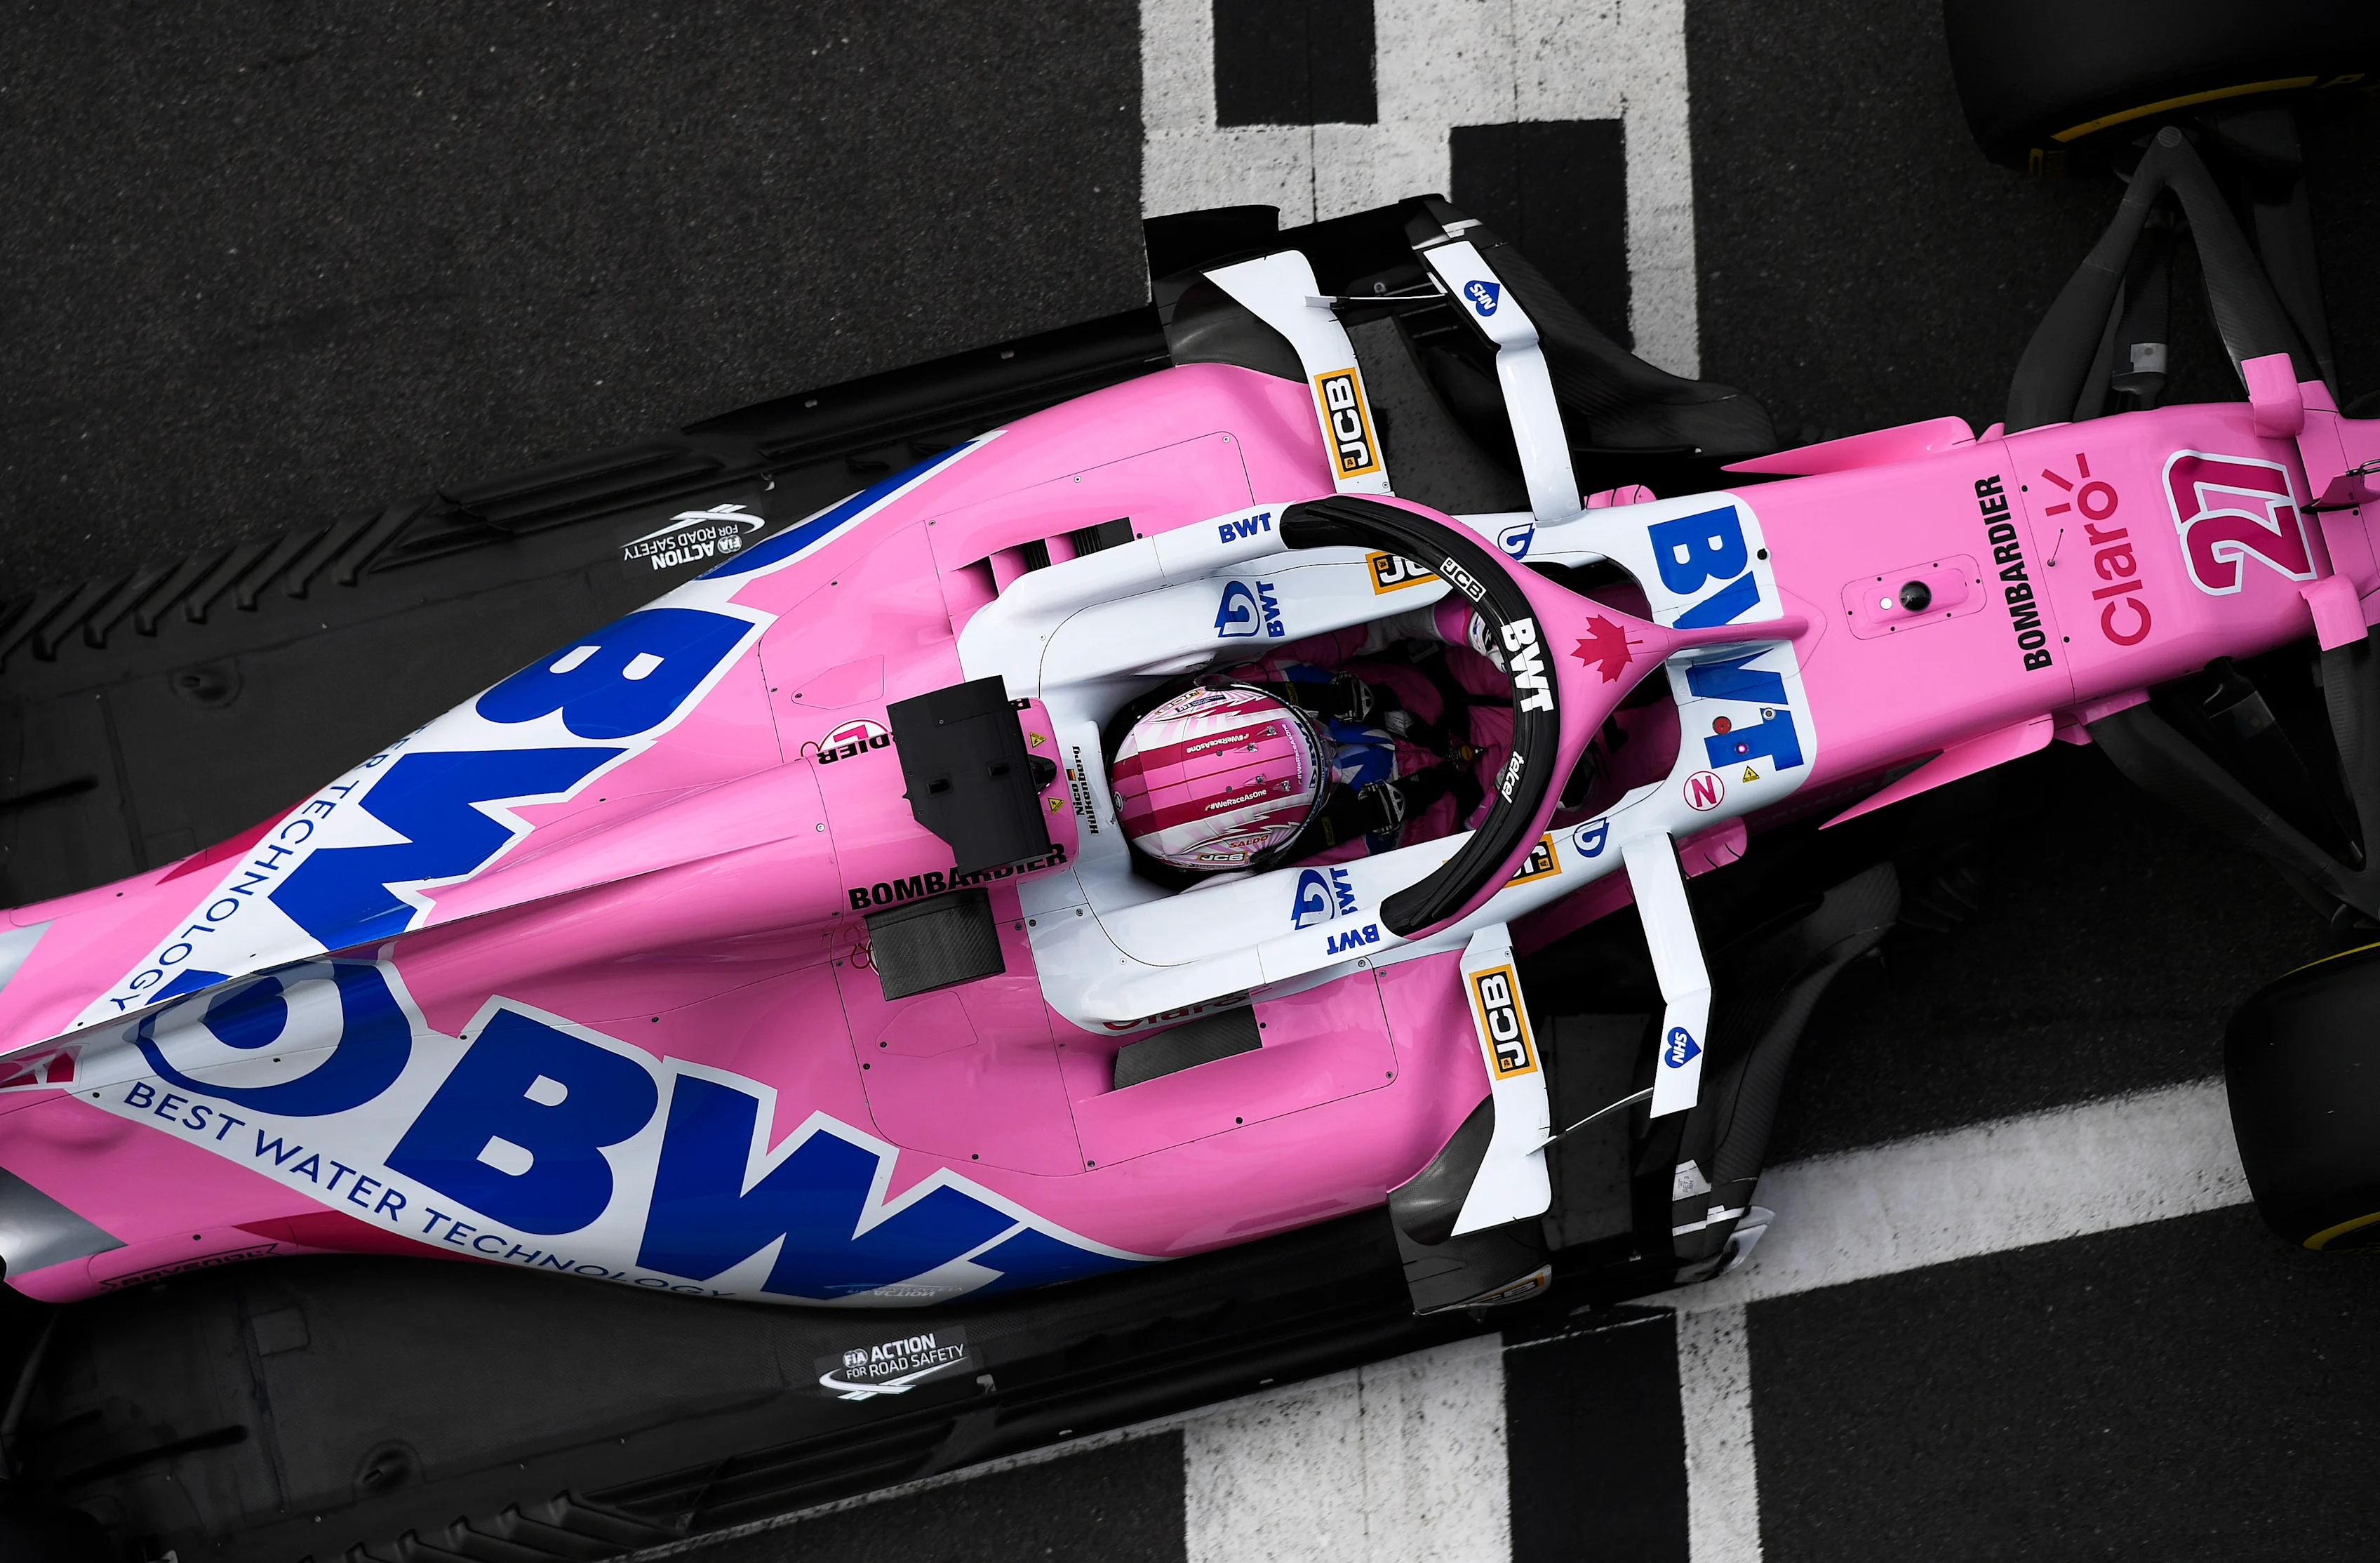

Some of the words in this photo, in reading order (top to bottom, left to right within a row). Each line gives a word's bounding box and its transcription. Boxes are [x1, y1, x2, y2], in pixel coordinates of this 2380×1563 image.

[1469, 283, 1496, 310] NHS
[1326, 377, 1369, 466] JCB
[678, 526, 716, 547] ROAD
[718, 524, 739, 537] FOR
[1218, 512, 1271, 544] BWT
[2163, 451, 2315, 594] 27
[624, 536, 676, 561] SAFETY
[651, 540, 715, 570] ACTION
[2077, 481, 2152, 646] Claro
[1379, 555, 1433, 583] JC
[1443, 564, 1483, 599] JCB
[1974, 473, 2053, 672] BOMBARDIER
[1256, 580, 1285, 638] BWT
[1647, 505, 1805, 771] BWT
[1500, 617, 1554, 713] BWT
[1186, 733, 1246, 753] #WeRaceAsOne
[1281, 724, 1302, 781] #WeRaceAsOne
[1072, 746, 1099, 834] Hülkenberg
[1502, 750, 1525, 804] telcel
[1071, 783, 1085, 816] Nico
[1209, 789, 1266, 810] #WeRaceAsOne
[1200, 853, 1244, 861] JCB
[110, 780, 360, 1011] TECHNOLOGY
[1326, 923, 1380, 955] BWT
[1480, 973, 1527, 1067] JCB
[1671, 1032, 1687, 1064] NHS
[123, 1081, 246, 1141] BEST
[255, 1129, 408, 1222] WATER
[424, 1206, 738, 1298] TECHNOLOGY
[846, 1365, 867, 1379] FOR
[868, 1357, 909, 1378] ROAD
[911, 1343, 965, 1368] SAFETY
[871, 1333, 937, 1362] ACTION
